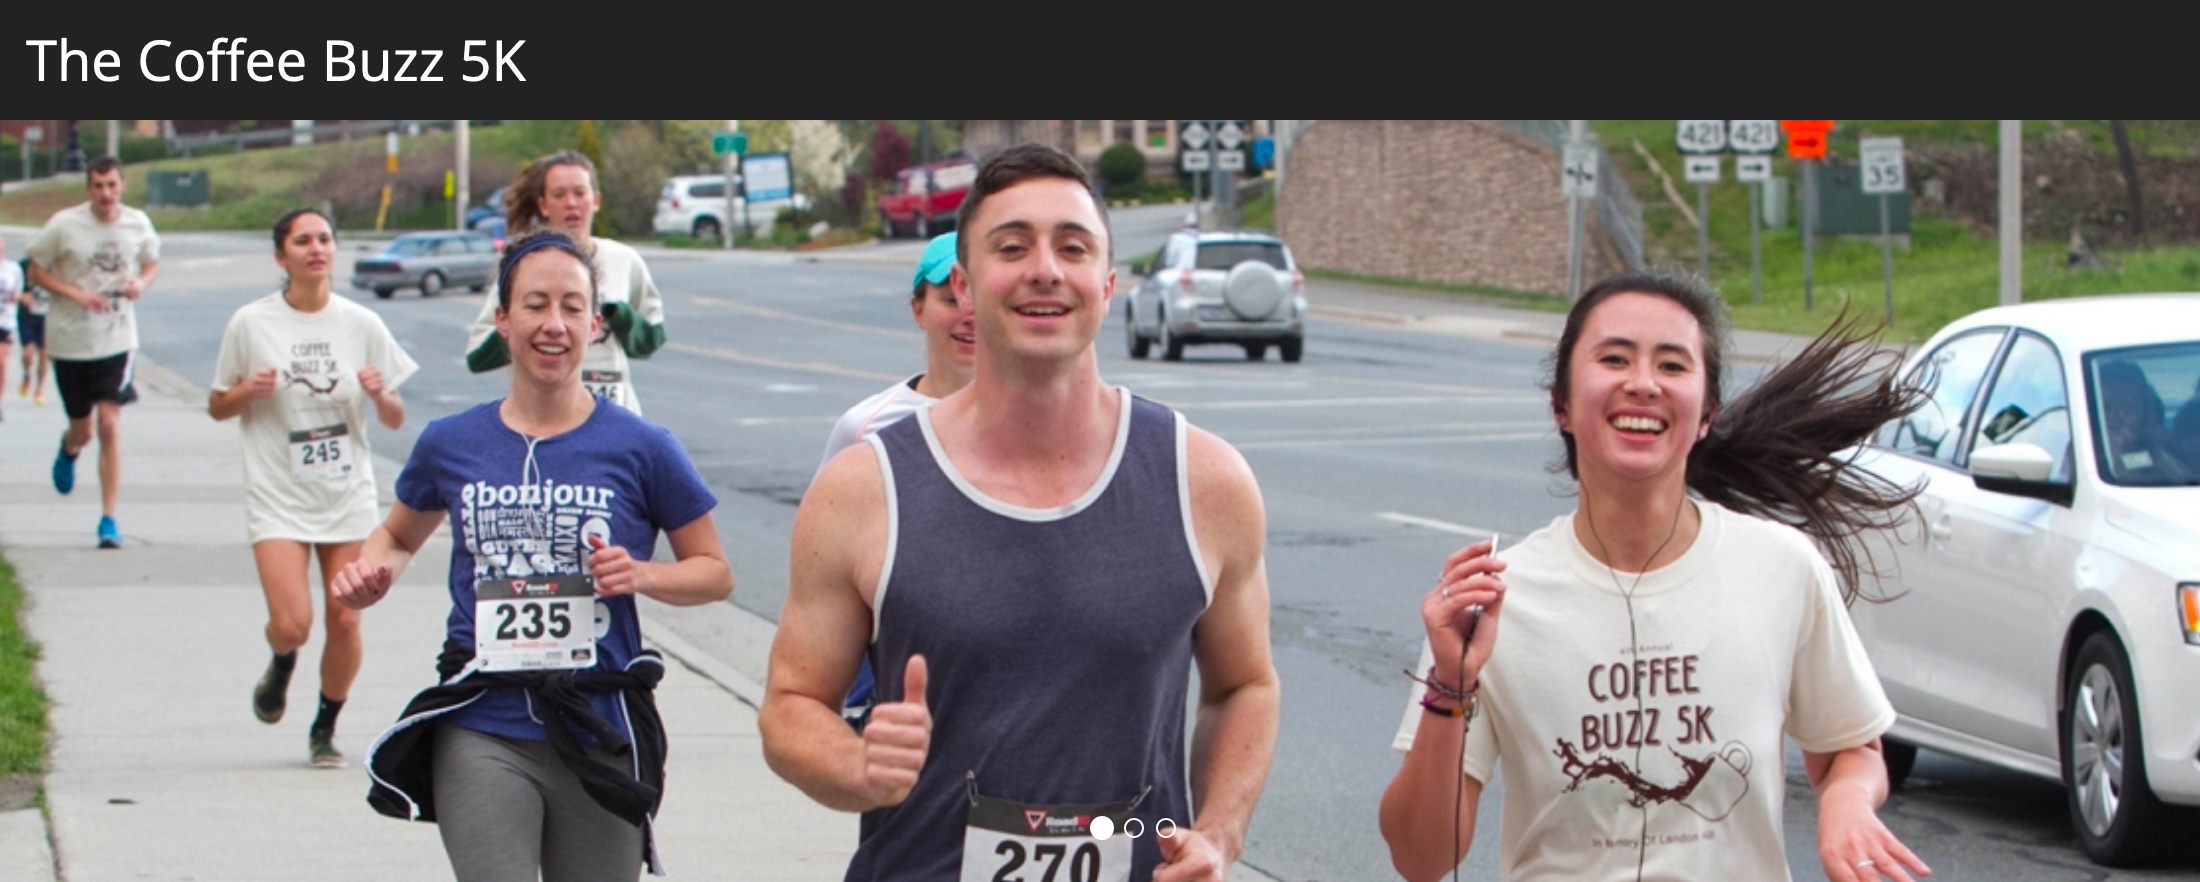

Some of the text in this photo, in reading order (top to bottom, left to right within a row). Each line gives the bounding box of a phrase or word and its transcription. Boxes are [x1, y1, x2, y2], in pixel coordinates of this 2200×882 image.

[1682, 122, 1721, 145] 421
[1735, 122, 1773, 144] 421
[1869, 164, 1900, 186] 35
[291, 342, 331, 357] COFFEE
[291, 359, 320, 374] BUZZ
[302, 440, 341, 464] 245
[477, 479, 615, 512] bonjour
[496, 601, 571, 640] 235
[1588, 655, 1700, 702] COFFEE
[1581, 705, 1716, 752] BUZZ 5K
[1660, 833, 1698, 845] Landon
[993, 840, 1102, 882] 270
